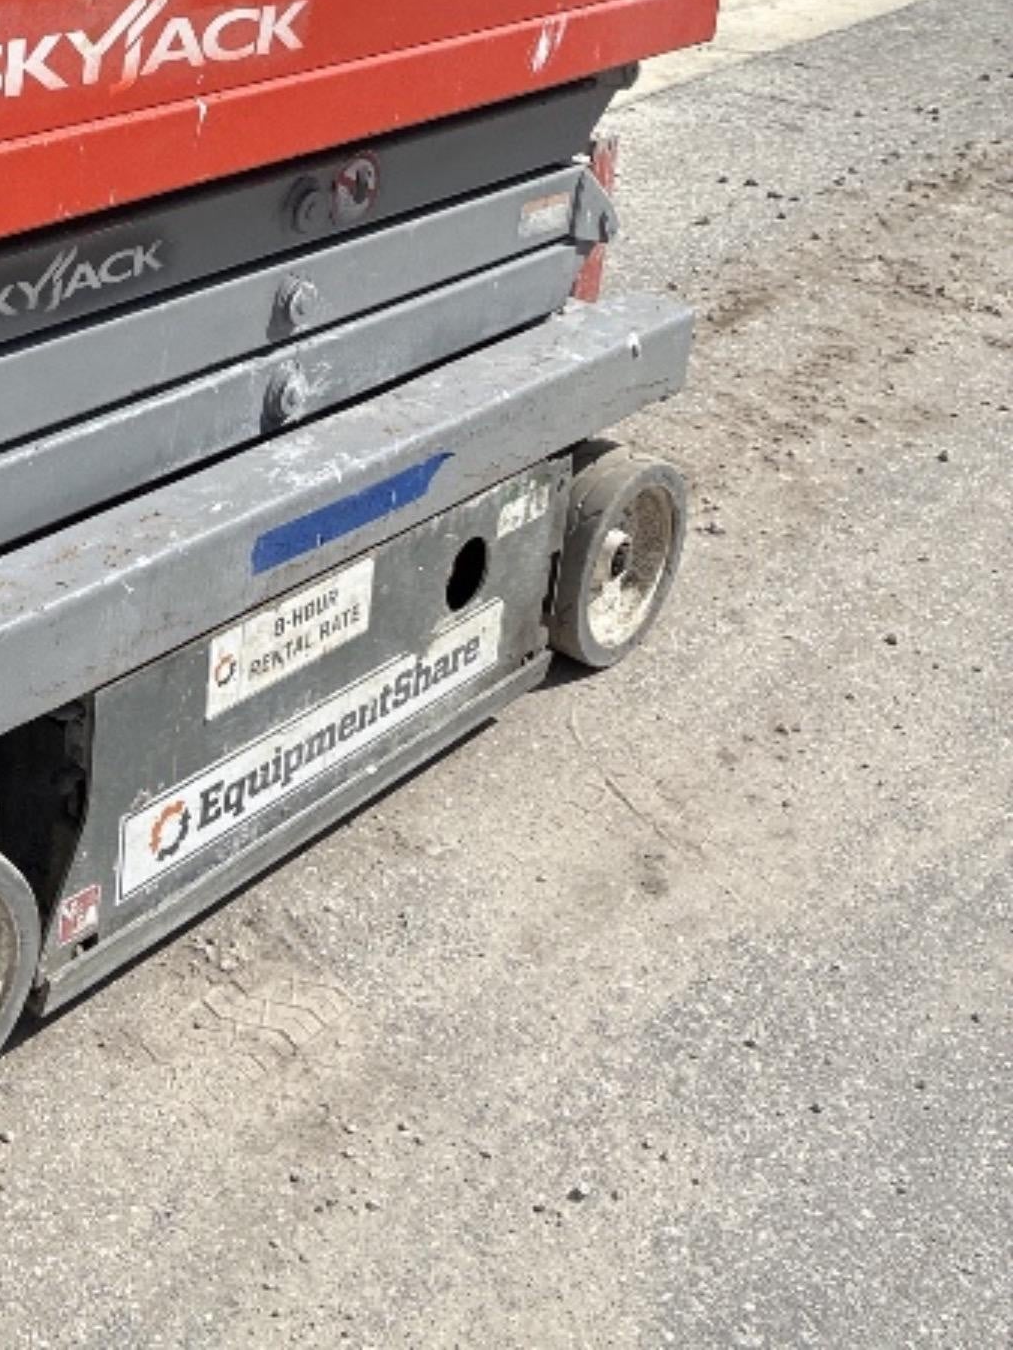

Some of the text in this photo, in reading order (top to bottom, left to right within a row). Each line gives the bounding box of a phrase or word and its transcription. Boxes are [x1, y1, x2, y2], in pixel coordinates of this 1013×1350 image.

[249, 601, 361, 680] RENTAL RATE
[195, 634, 482, 832] EquipmentShare
